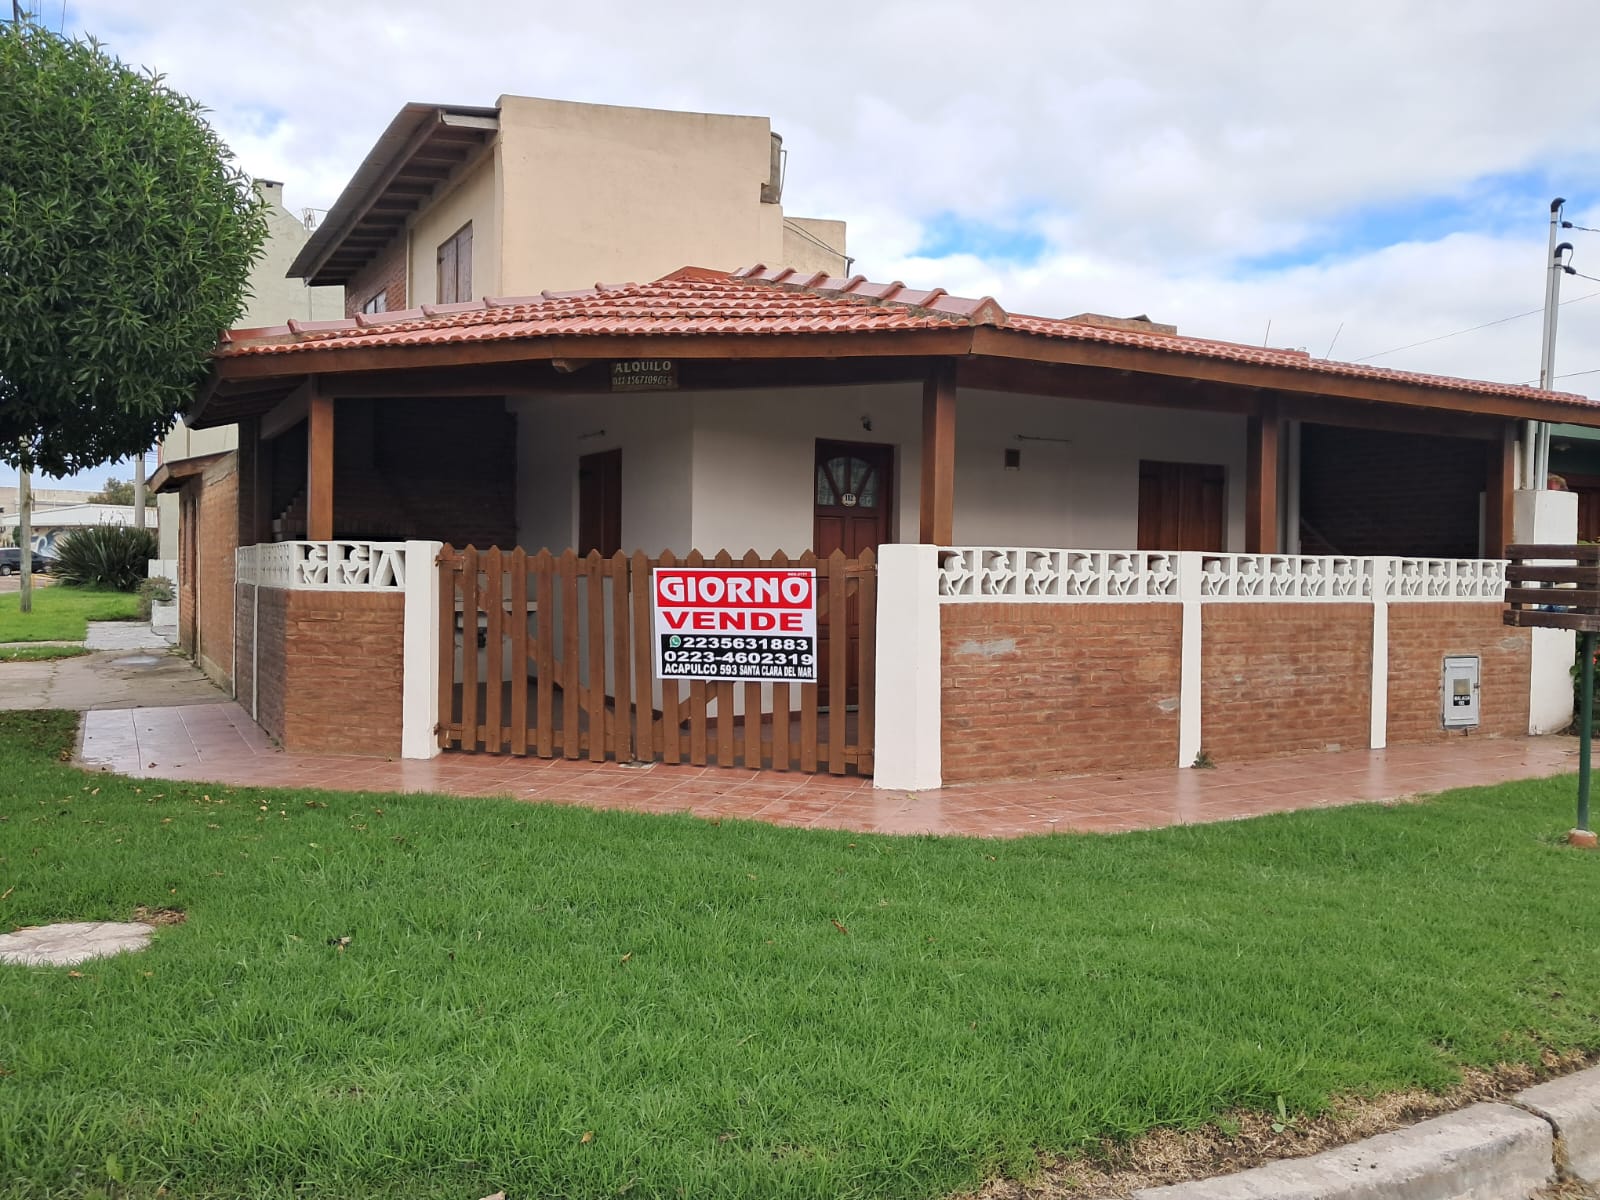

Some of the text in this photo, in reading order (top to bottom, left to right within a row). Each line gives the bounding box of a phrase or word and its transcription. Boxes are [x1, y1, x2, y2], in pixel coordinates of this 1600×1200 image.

[615, 361, 672, 373] ALQUILO
[659, 576, 810, 604] GIORNO
[662, 611, 804, 631] VENDE
[683, 637, 809, 651] 2235631883
[664, 651, 813, 665] 0223-4602319
[664, 663, 812, 678] ACAPULCO 593 SANTA CLARA DEL MAR
